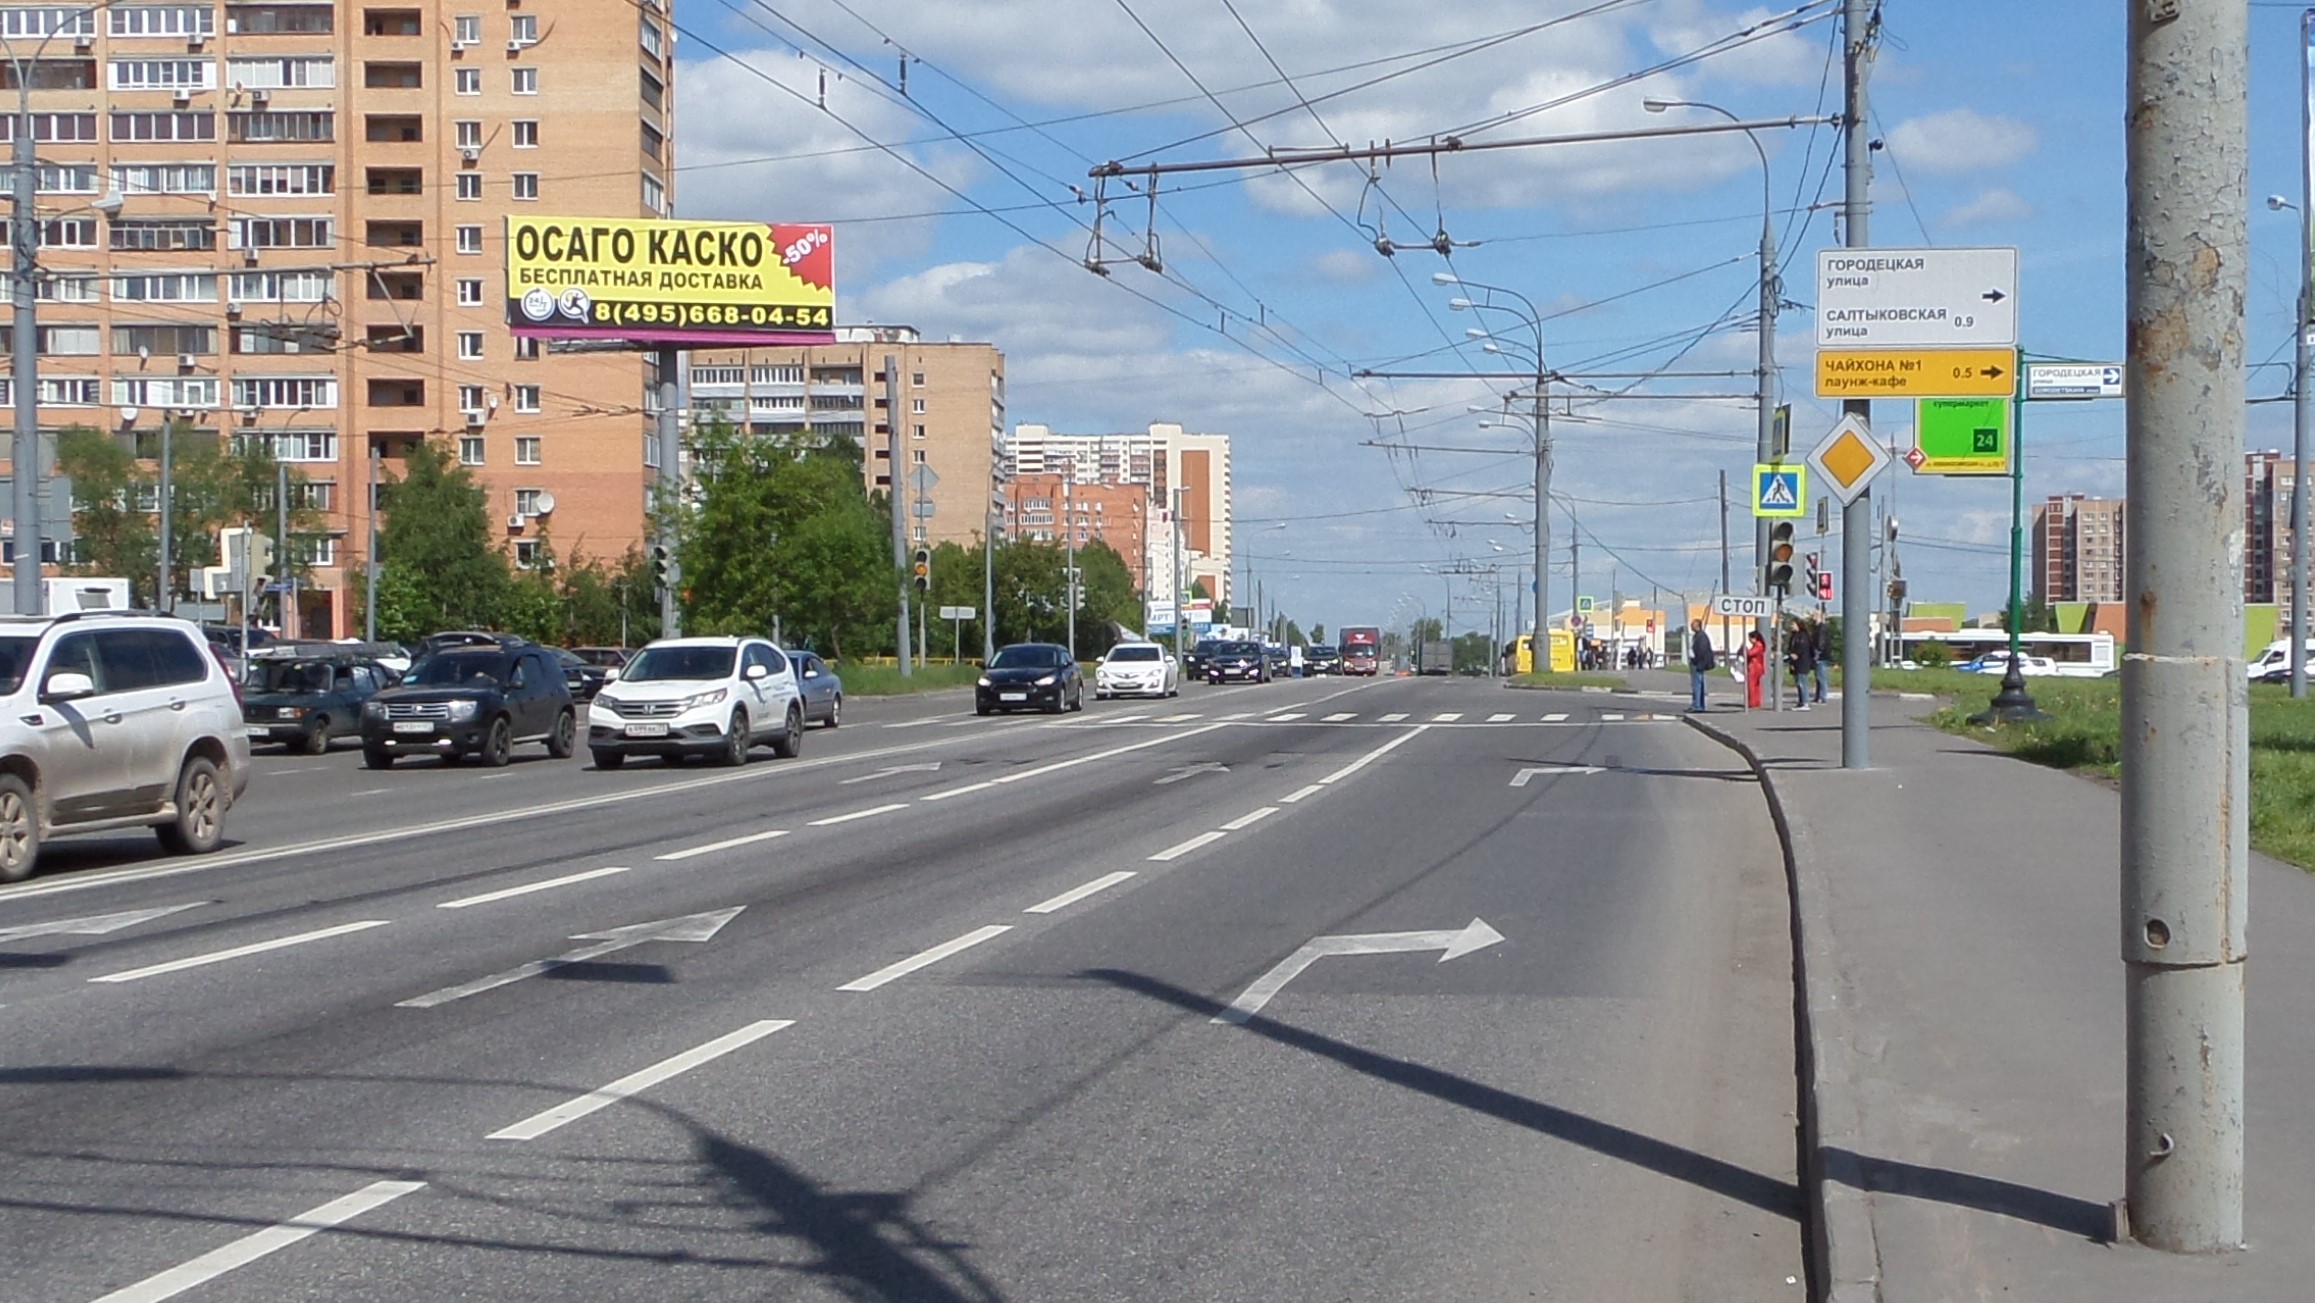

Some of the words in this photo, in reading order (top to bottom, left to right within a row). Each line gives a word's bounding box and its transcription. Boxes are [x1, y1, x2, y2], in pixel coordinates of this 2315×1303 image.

[516, 224, 635, 263] ОСАГО
[648, 228, 763, 268] КАСКО
[782, 228, 828, 265] -50%
[1827, 258, 1925, 272] ГОРОДЕЦКАЯ
[519, 268, 653, 287] БЕСПЛАТНАЯ
[659, 272, 763, 291] ДОСТАВКА
[1826, 276, 1869, 289] улица
[595, 303, 829, 328] 8(495)668-04-54
[1826, 309, 1947, 322] САЛТЫКОВСКАЯ
[1954, 316, 1974, 328] 0.9
[1826, 327, 1868, 339] улица
[1825, 358, 1895, 372] ЧАЙХОНА
[1899, 360, 1922, 372] №1
[1952, 367, 1973, 379] 0.5
[2032, 368, 2101, 378] ГОРОДЕЦКАЯ
[1825, 375, 1907, 388] лаунж-кафе
[1976, 434, 1994, 447] 24
[1721, 598, 1765, 614] СТОП
